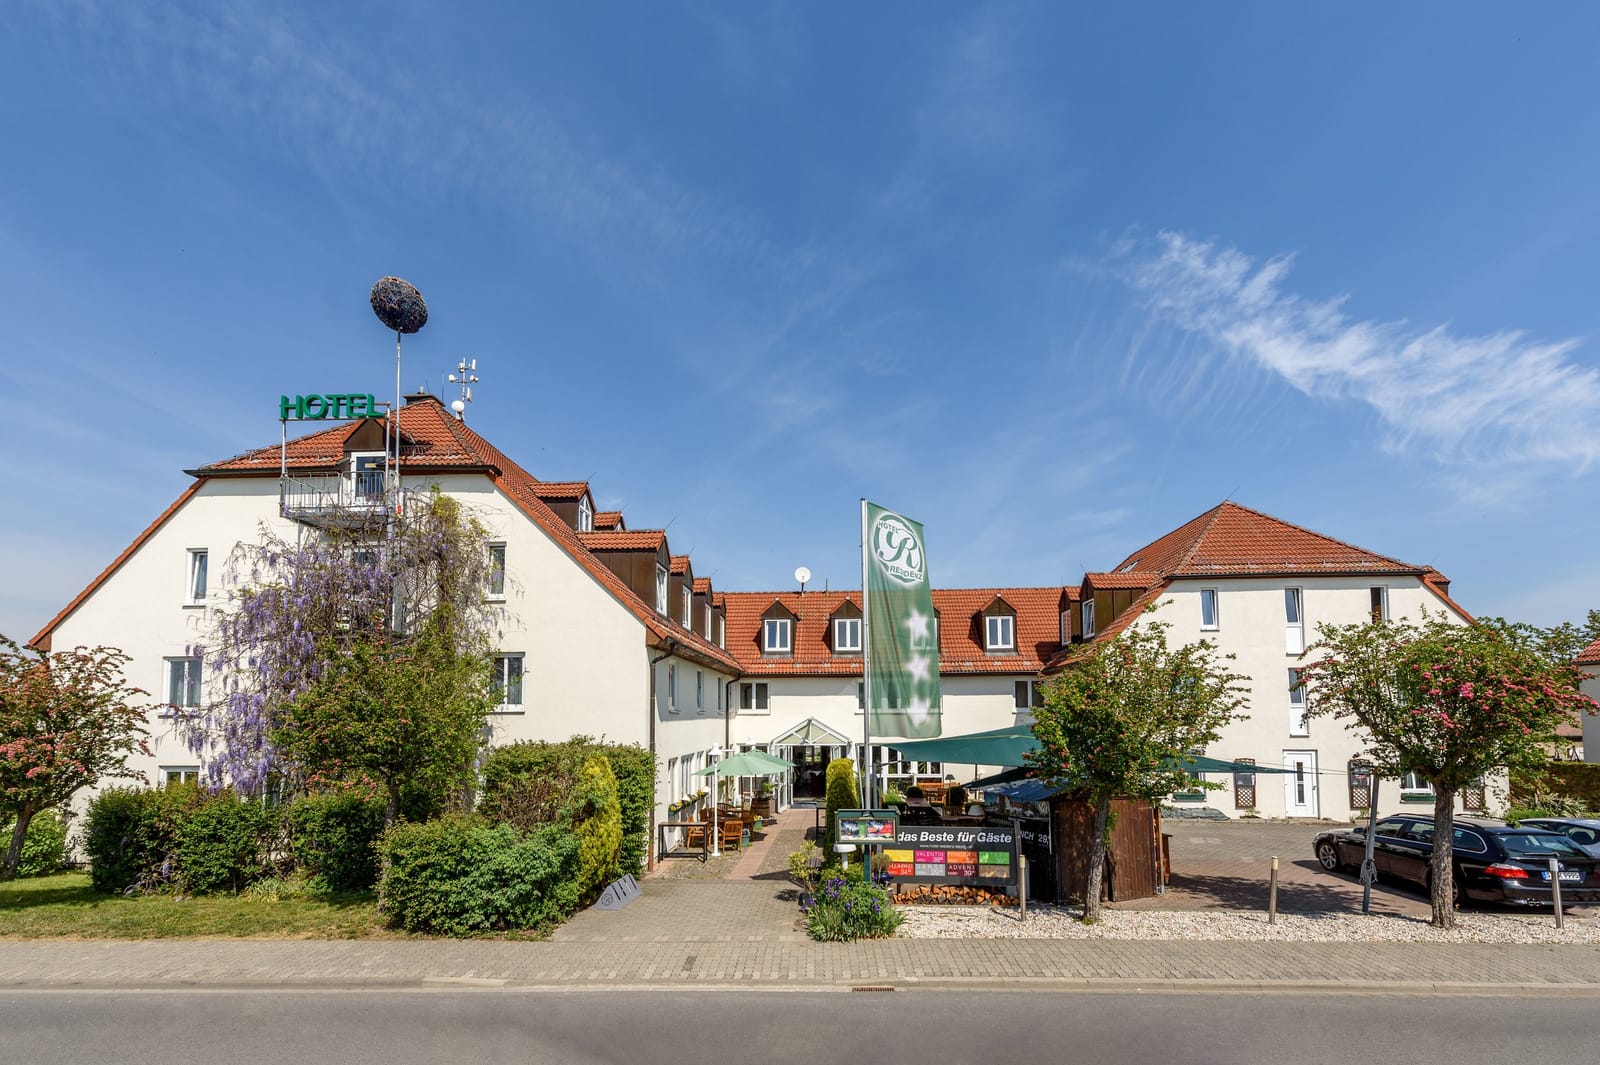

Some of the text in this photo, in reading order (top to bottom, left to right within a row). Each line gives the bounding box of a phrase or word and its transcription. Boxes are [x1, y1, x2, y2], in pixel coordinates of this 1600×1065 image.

[280, 393, 385, 420] HOTEL
[878, 520, 899, 534] HOTEL
[897, 831, 1012, 843] das Beste für Gäste
[1020, 830, 1049, 845] NCH 29,
